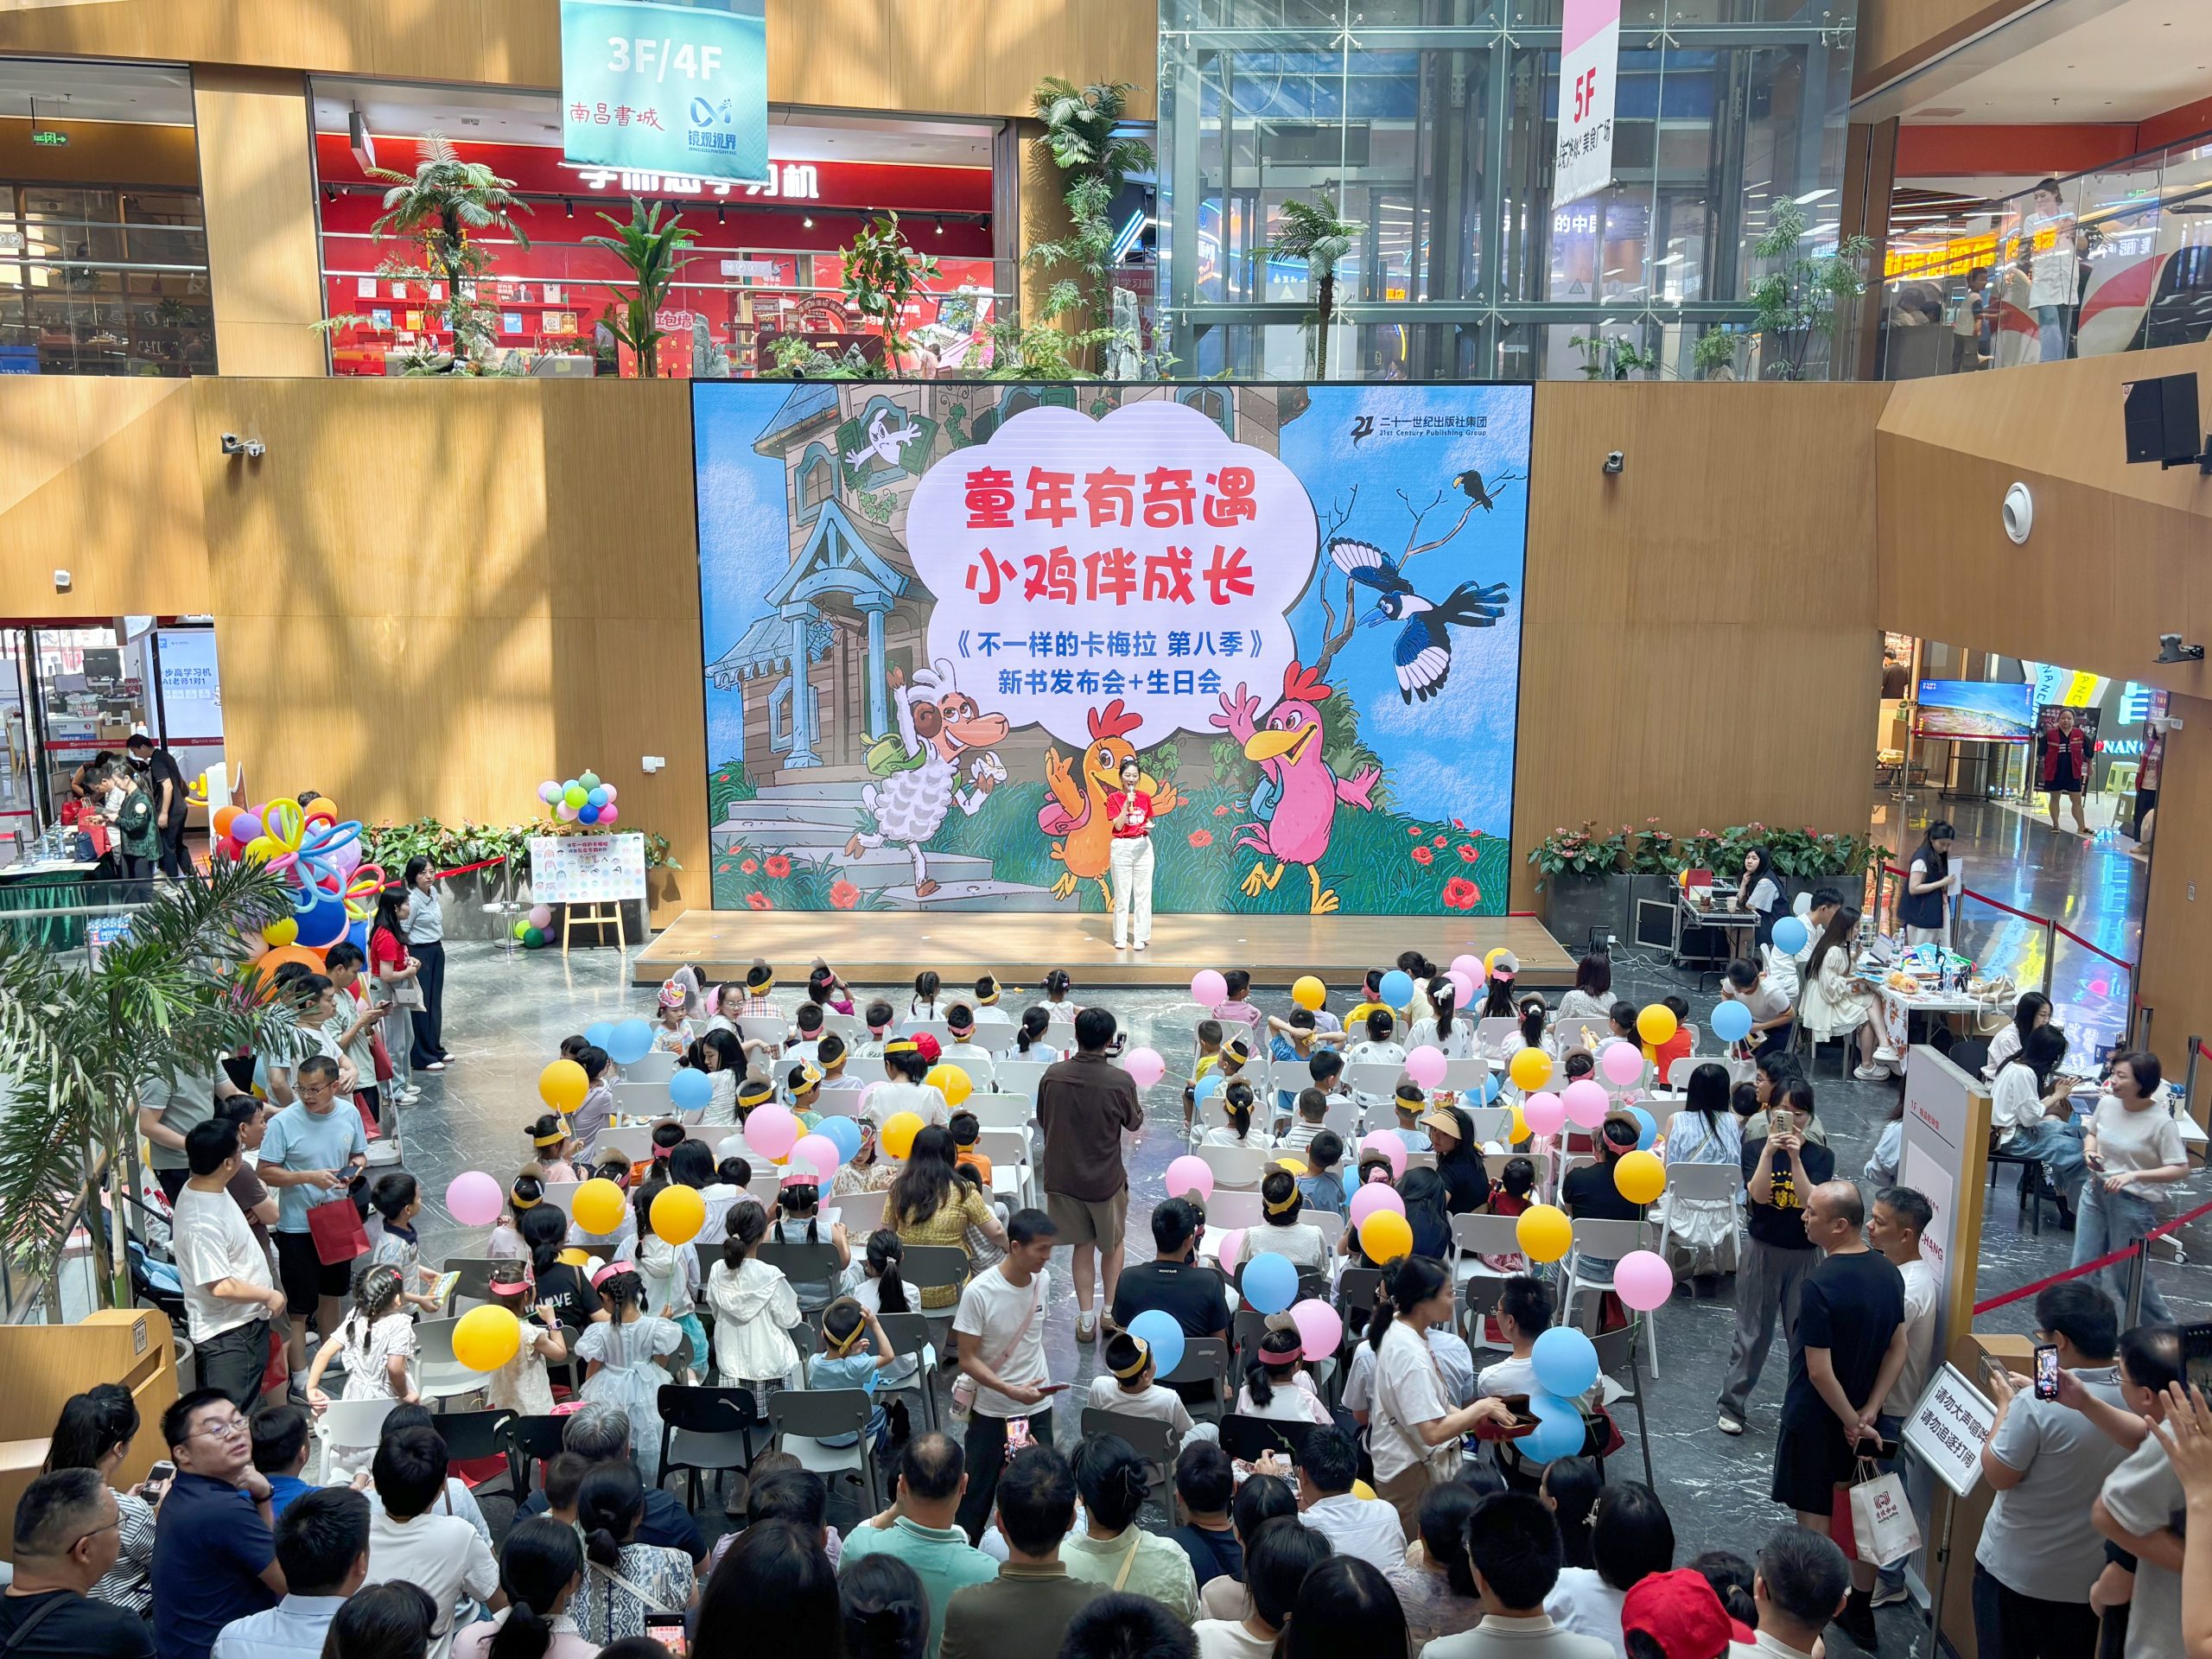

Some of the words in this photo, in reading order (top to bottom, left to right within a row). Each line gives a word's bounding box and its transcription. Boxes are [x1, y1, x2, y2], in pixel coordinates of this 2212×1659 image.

[607, 36, 722, 83] 3F/4F
[1573, 67, 1596, 124] 5F
[569, 102, 665, 130] 南昌書城
[689, 130, 736, 149] 镜观视界
[1583, 118, 1611, 155] 美食广场
[1379, 416, 1487, 428] 二十一世纪出版社集团
[964, 466, 1257, 529] 童年有奇遇
[964, 545, 1255, 606] 小鸡伴成长
[957, 629, 1158, 658] 《不一样的卡梅拉
[1167, 629, 1264, 658] 第八季》
[162, 668, 212, 677] 步高学习机
[998, 668, 1222, 696] 新书发布会+生日会
[1935, 1385, 1991, 1444] 请勿大声喧哗
[1920, 1407, 1976, 1469] 请勿追逐打闹
